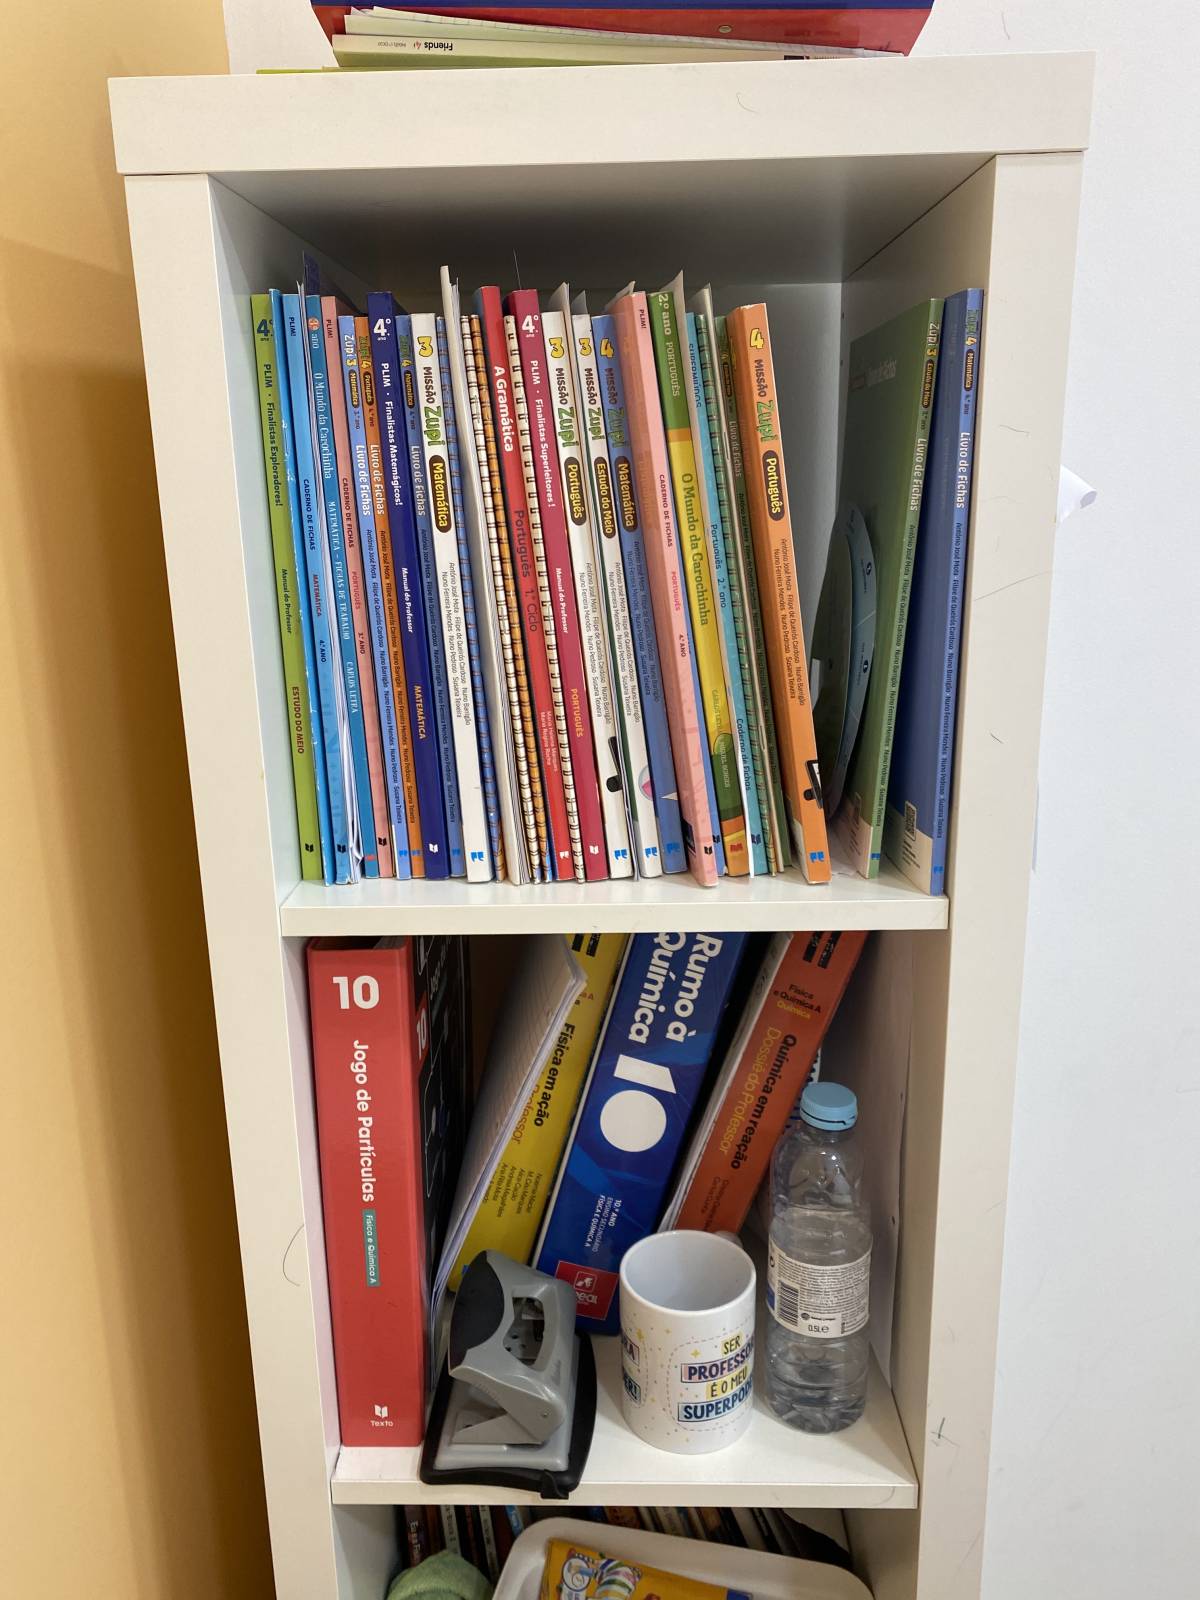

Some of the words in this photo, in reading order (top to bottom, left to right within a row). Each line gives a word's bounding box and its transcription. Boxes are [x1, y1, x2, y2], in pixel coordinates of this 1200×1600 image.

[424, 41, 454, 51] Friends
[288, 316, 296, 336] PLIM!
[638, 308, 646, 329] PLIM!
[343, 334, 354, 357] Zupi
[416, 334, 434, 358] 3
[547, 336, 564, 359] 3
[578, 336, 592, 356] 3
[926, 322, 939, 346] Zupi
[346, 358, 355, 366] 3
[925, 347, 936, 356] 3
[263, 363, 272, 387] PLIM
[380, 362, 390, 387] PLIM
[493, 364, 505, 376] A
[529, 359, 540, 384] PLIM
[665, 341, 681, 397] PORTUGUÊS
[754, 358, 767, 397] MISSÃO
[965, 352, 974, 388] Matemática
[314, 381, 326, 411] Mundo
[348, 372, 358, 405] Matemática
[422, 366, 436, 404] MISSÃO
[554, 366, 569, 405] MISSÃO
[584, 367, 598, 405] MISSÃO
[603, 367, 618, 404] MISSÃO
[266, 402, 277, 444] Finalistas
[318, 414, 327, 424] da
[384, 400, 396, 443] Finalistas
[421, 404, 445, 447] Zupi
[495, 378, 516, 452] Gramática
[534, 398, 547, 441] Finalistas
[554, 405, 578, 448] Zupi
[586, 406, 604, 441] Zupi
[605, 406, 629, 449] Zupi
[753, 399, 777, 442] Zupi
[319, 427, 333, 479] Carochinha
[354, 445, 366, 468] Livro
[369, 444, 381, 467] Livro
[410, 445, 421, 469] Livro
[915, 438, 927, 462] Livro
[958, 432, 970, 457] Livro
[268, 446, 283, 506] Exploradores!
[357, 469, 368, 482] de
[372, 468, 382, 480] de
[387, 444, 403, 506] Matemágicos!
[413, 470, 423, 483] de
[596, 462, 609, 495] Estudo
[681, 473, 693, 483] O
[913, 464, 924, 477] de
[957, 459, 968, 473] de
[431, 461, 450, 527] Matemática
[565, 463, 585, 518] Português
[617, 462, 635, 527] Matemática
[764, 457, 782, 513] Português
[909, 479, 922, 511] Fichas
[955, 475, 967, 508] Fichas
[341, 477, 350, 510] CADERNO
[346, 523, 354, 548] FICHAS
[358, 484, 371, 516] Fichas
[373, 483, 386, 515] Fichas
[414, 484, 426, 516] Fichas
[600, 496, 610, 508] do
[658, 474, 668, 508] CADERNO
[664, 521, 673, 547] FICHAS
[682, 486, 699, 531] Mundo
[303, 478, 311, 511] CADERNO
[307, 525, 315, 550] FICHAS
[328, 500, 341, 550] MATEMÁTICA
[602, 510, 614, 533] Meio
[688, 534, 701, 550] da
[281, 568, 289, 593] Manual
[334, 561, 344, 588] FICHAS
[400, 567, 409, 592] Manual
[440, 571, 449, 586] Nuno
[447, 562, 456, 584] António
[511, 509, 532, 577] Português
[525, 602, 539, 631] Ciclo
[554, 567, 564, 592] Manual
[312, 573, 322, 617] MATEMÁTICA
[337, 589, 346, 600] DE
[351, 570, 361, 609] PORTUGUÊS
[442, 587, 451, 608] Ferreira
[450, 585, 458, 597] José
[557, 592, 565, 601] do
[670, 570, 681, 611] PORTUGUÊS
[691, 551, 711, 625] Carochinha
[718, 591, 726, 608] ano
[284, 603, 293, 633] Professor
[404, 602, 414, 633] Professor
[451, 598, 460, 613] Mota
[559, 602, 569, 633] Professor
[338, 602, 350, 640] TRABALHO
[444, 609, 454, 632] Mendes
[453, 616, 461, 631] Filipe
[447, 634, 455, 650] Nuno
[456, 640, 465, 661] Queirós
[449, 650, 458, 673] Pedroso
[458, 661, 467, 683] Cardoso
[452, 676, 460, 696] Susana
[461, 687, 469, 701] Nuno
[291, 686, 301, 718] ESTUDO
[413, 684, 426, 739] MATEMÁTICA
[454, 697, 463, 717] Teixeira
[462, 702, 471, 725] Barrigão
[569, 687, 584, 737] PORTUGUÊS
[294, 720, 302, 731] DO
[295, 732, 304, 753] MEIO
[736, 718, 747, 752] Caderno
[742, 765, 752, 790] Fichas
[628, 933, 685, 1043] Química
[675, 932, 723, 1018] Rumo
[332, 975, 380, 1010] 10
[551, 1022, 576, 1066] Física
[666, 1021, 696, 1042] à
[348, 1039, 370, 1084] Jogo
[752, 1026, 780, 1074] Dossiê
[762, 1034, 797, 1094] Química
[544, 1067, 560, 1090] em
[745, 1072, 760, 1092] do
[355, 1088, 371, 1111] de
[532, 1091, 554, 1127] ação
[751, 1096, 769, 1120] em
[718, 1092, 754, 1156] Professor
[730, 1120, 758, 1170] reação
[357, 1116, 378, 1202] Partículas
[594, 1194, 605, 1213] FÍSICA
[723, 1336, 740, 1355] SER
[730, 1366, 748, 1390] MEU
